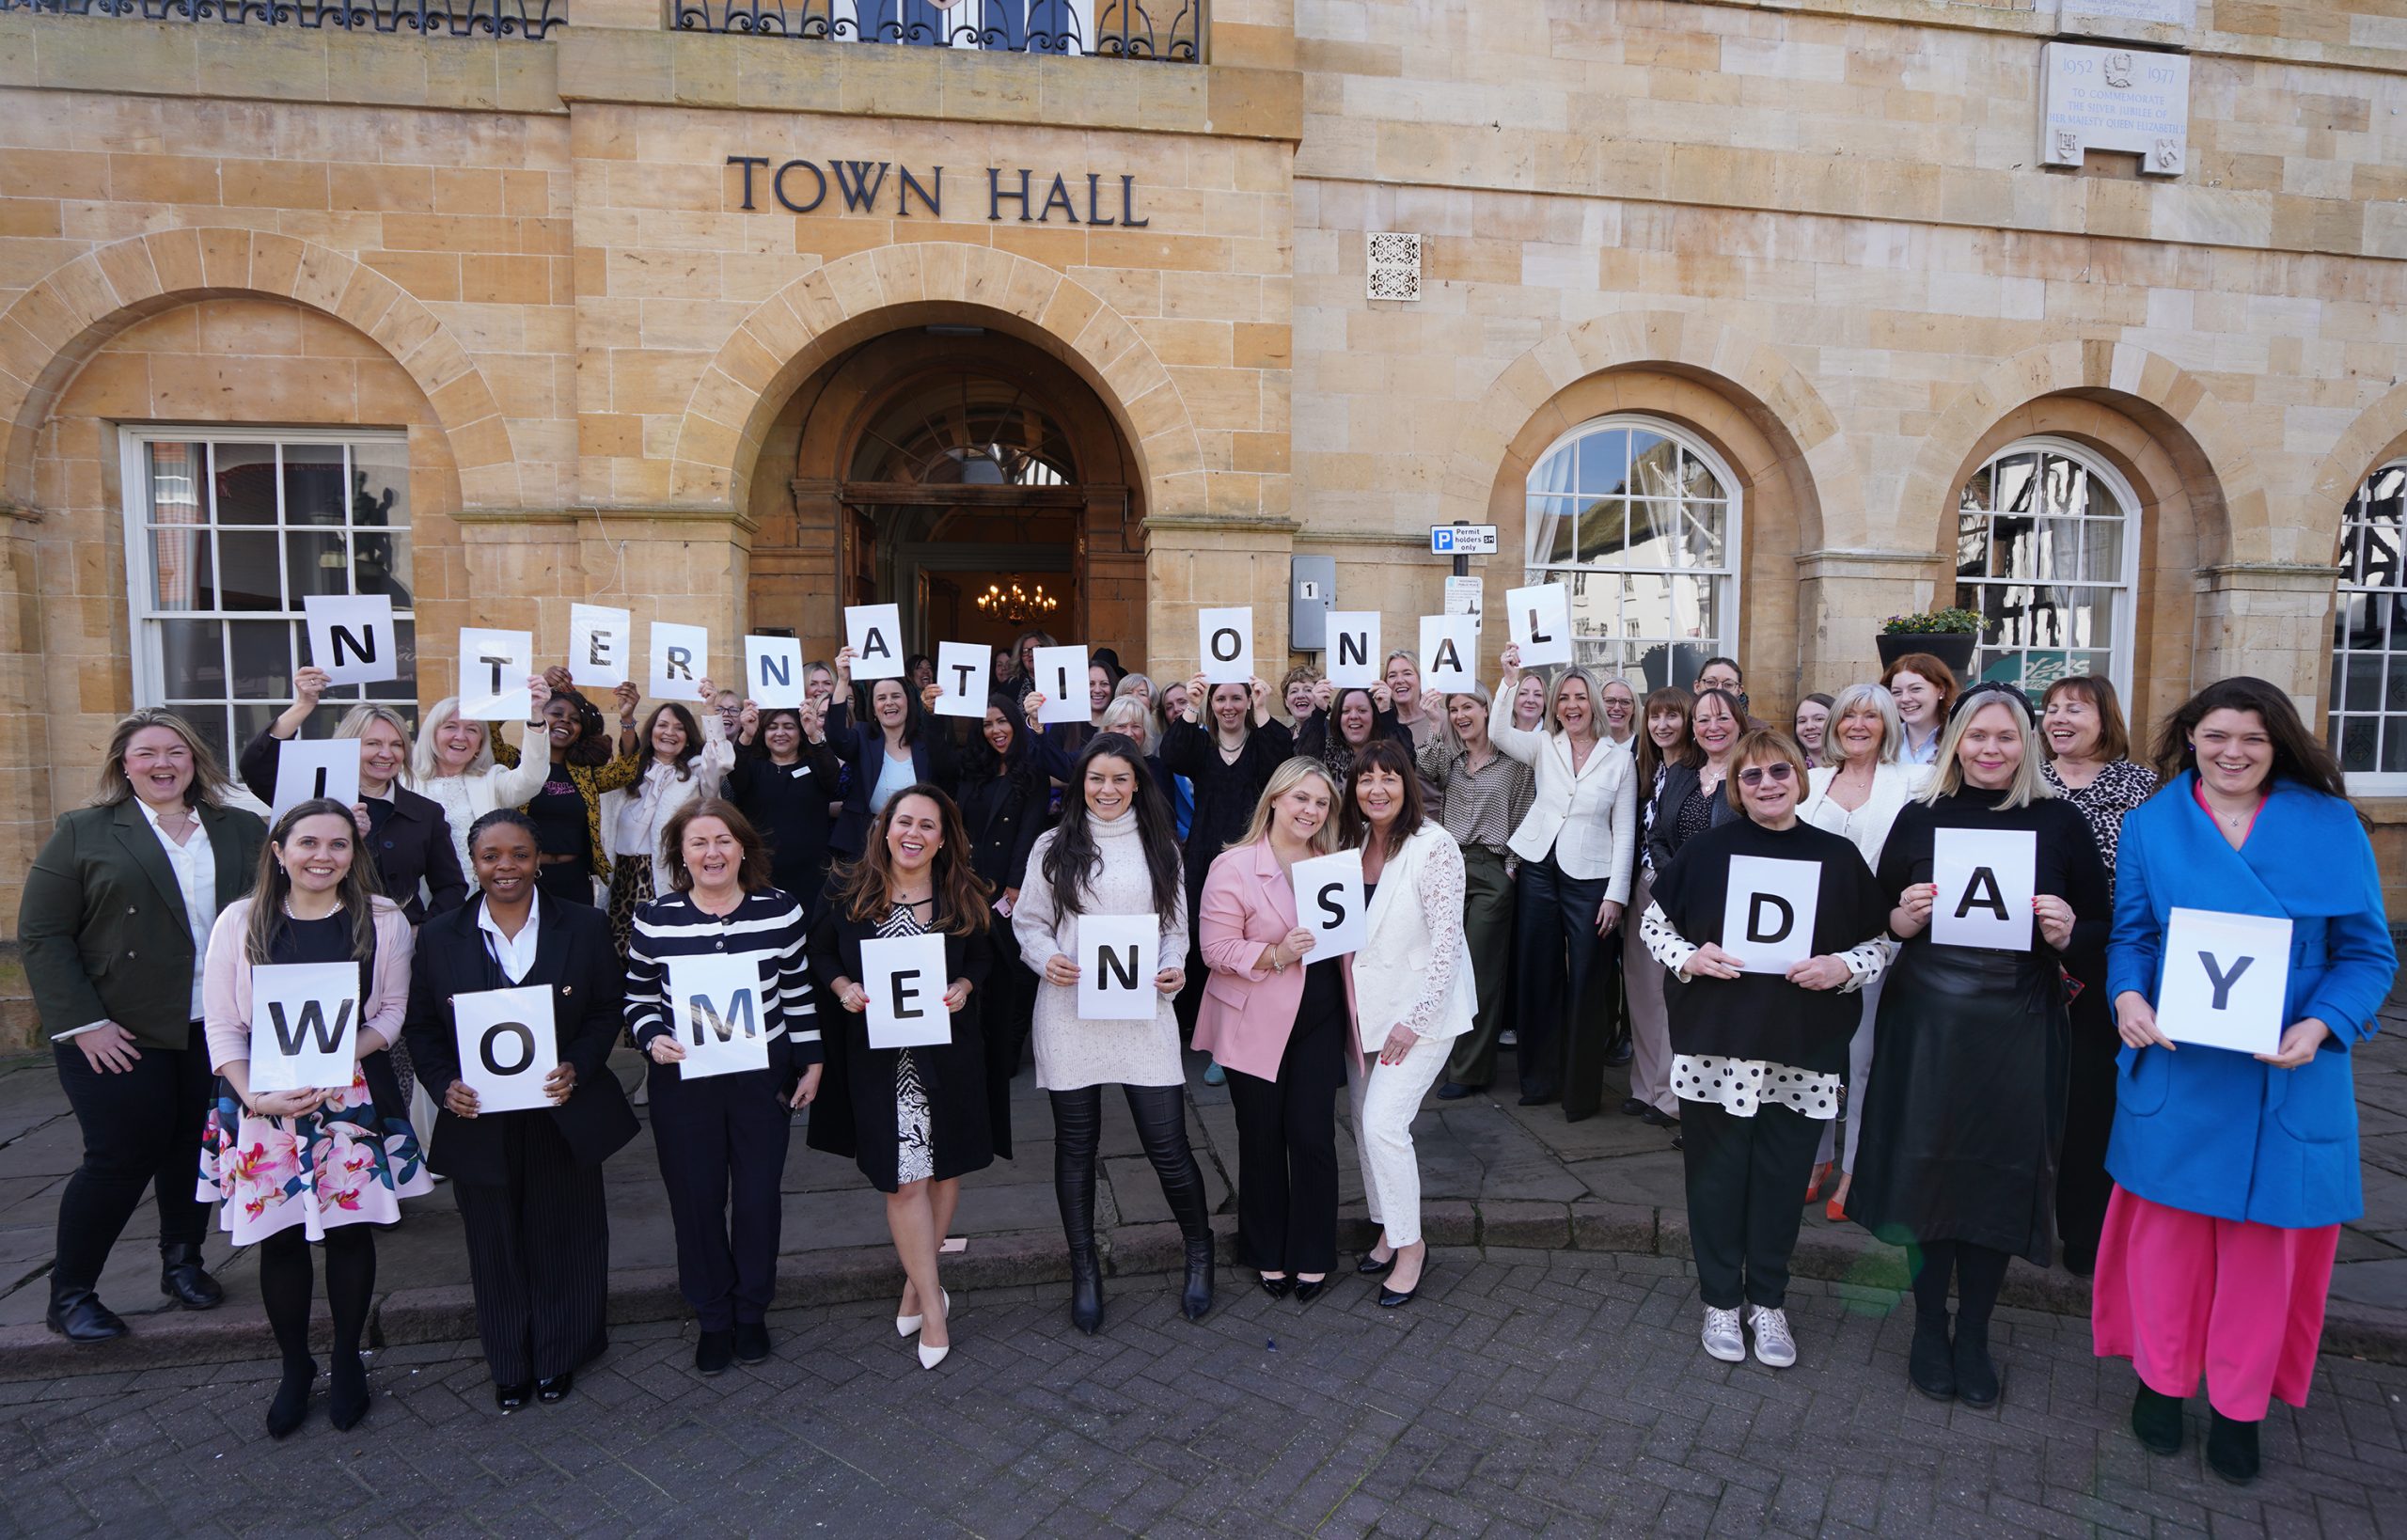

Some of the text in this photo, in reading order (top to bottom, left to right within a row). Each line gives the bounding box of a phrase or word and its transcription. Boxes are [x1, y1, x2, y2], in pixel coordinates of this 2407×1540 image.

[2063, 58, 2175, 85] 1952 1977
[2068, 101, 2167, 118] THE SILVER JUBILEE OF
[2072, 87, 2165, 105] TO COMMEMORATE
[2049, 113, 2066, 123] HER
[2068, 115, 2103, 128] MAJESTY
[2106, 118, 2134, 130] QUEEN
[2137, 121, 2179, 134] ELIZABETH
[726, 155, 1150, 228] TOWN HALL
[1439, 532, 1450, 548] P
[1306, 584, 1312, 597] 1
[862, 627, 890, 659] A
[1530, 609, 1551, 643] L
[330, 624, 376, 667] N
[590, 630, 611, 666] E
[1211, 628, 1241, 661] O
[1340, 632, 1367, 666] N
[1432, 638, 1462, 672] A
[480, 656, 512, 696] T
[668, 647, 692, 680] R
[761, 655, 789, 685] N
[952, 665, 976, 697] T
[1059, 668, 1066, 699] I
[1317, 883, 1345, 929] S
[1954, 867, 2009, 920] A
[1747, 892, 1794, 943] D
[1098, 945, 1138, 990] N
[2198, 951, 2254, 1010] Y
[891, 969, 923, 1019] E
[268, 999, 354, 1056] W
[690, 988, 765, 1045] M
[480, 1022, 535, 1076] O
